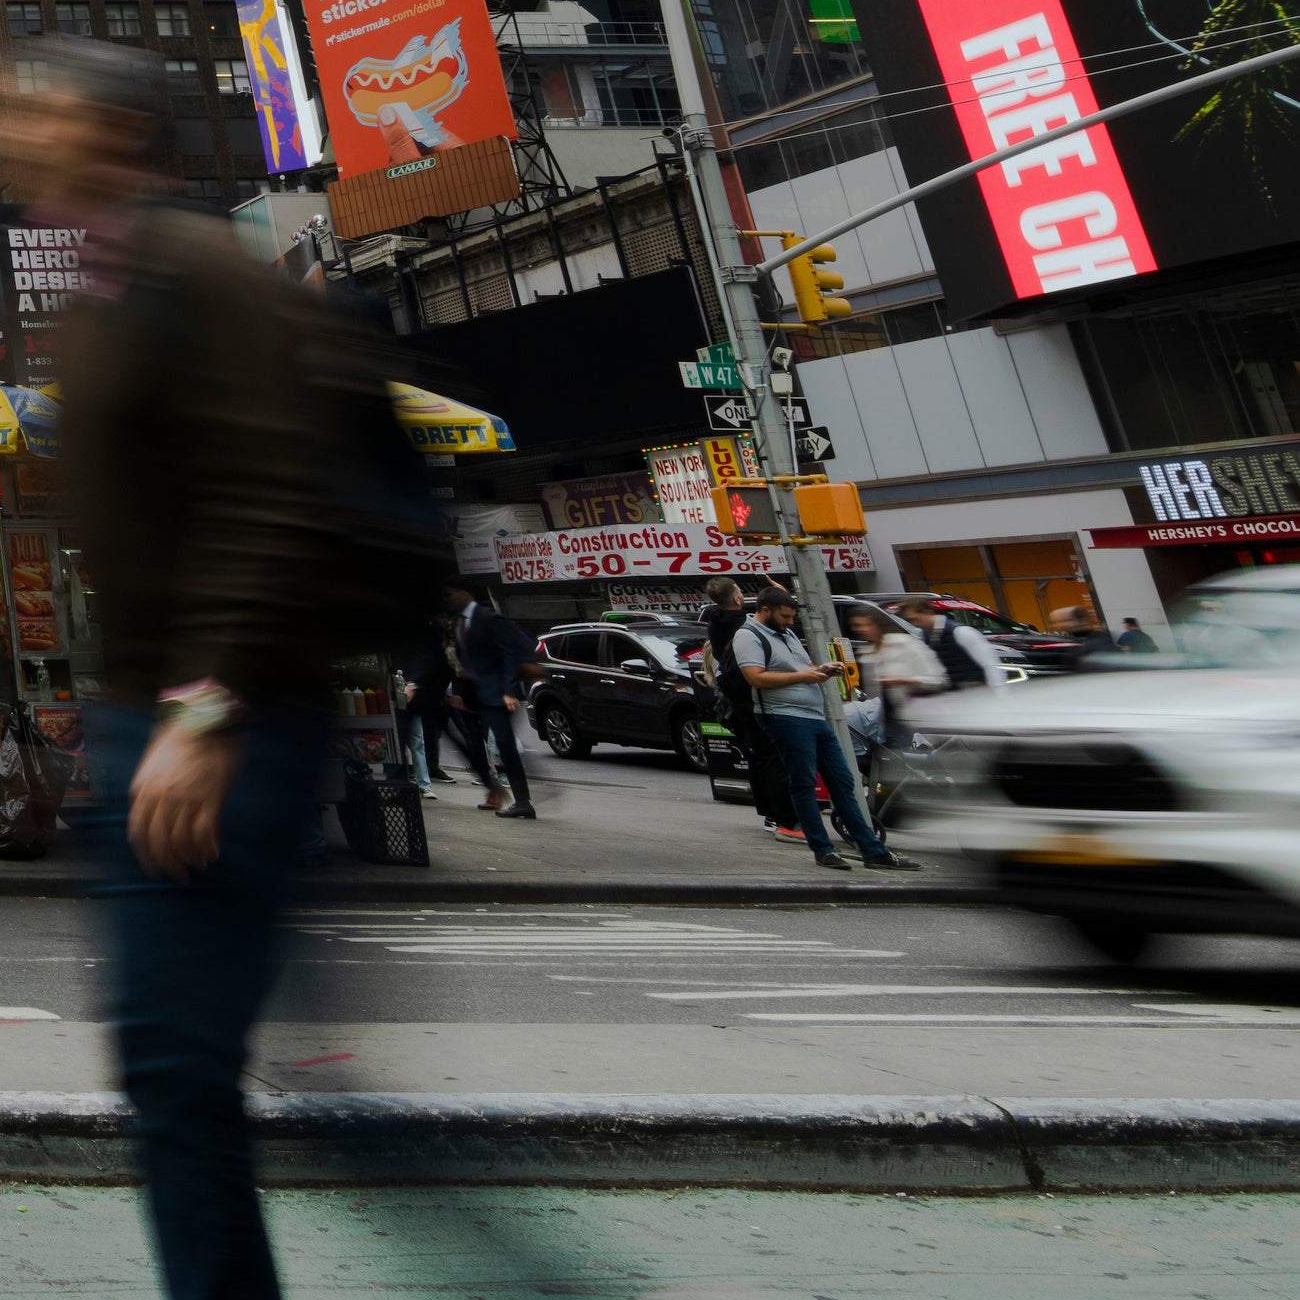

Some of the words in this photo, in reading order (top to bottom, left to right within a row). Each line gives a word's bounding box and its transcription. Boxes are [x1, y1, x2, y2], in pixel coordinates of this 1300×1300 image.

[960, 12, 1096, 188] FREE
[388, 158, 434, 178] LAMAR
[7, 228, 87, 248] EVERY
[10, 249, 81, 269] HERO
[18, 293, 37, 312] A
[717, 348, 723, 360] 7
[701, 367, 714, 385] W
[716, 367, 732, 385] 47
[724, 406, 751, 420] ONE
[655, 457, 679, 476] NEW
[711, 441, 736, 485] LUG
[740, 442, 756, 479] LOWE
[564, 493, 644, 528] GIFTS
[680, 508, 704, 523] THE
[558, 526, 690, 556] Construction
[1147, 524, 1227, 541] HERSHEY'S
[496, 537, 537, 560] Construction
[537, 536, 553, 557] Sale
[737, 562, 772, 572] OFF
[856, 560, 871, 570] OFF
[611, 595, 639, 605] SALE
[647, 594, 673, 604] SALE
[680, 593, 704, 603] SALE
